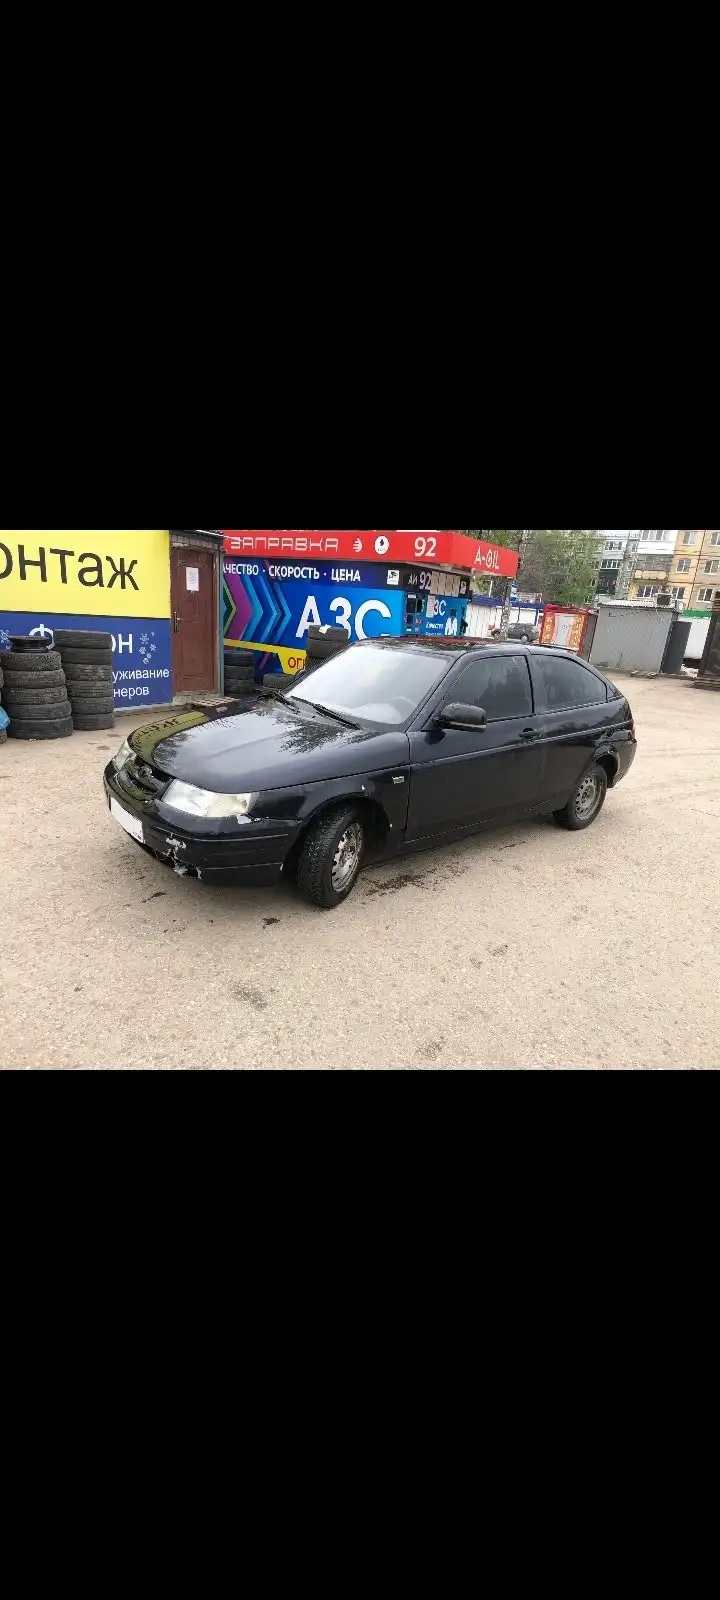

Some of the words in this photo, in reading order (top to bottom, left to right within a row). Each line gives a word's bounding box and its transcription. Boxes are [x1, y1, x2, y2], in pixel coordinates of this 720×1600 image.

[230, 537, 339, 552] ЗАПРАВКА
[414, 536, 437, 557] 92
[268, 565, 320, 580] СКОРОСТЬ
[331, 568, 361, 583] ЦЕНА
[419, 571, 432, 590] 92
[295, 595, 392, 640] АЗС
